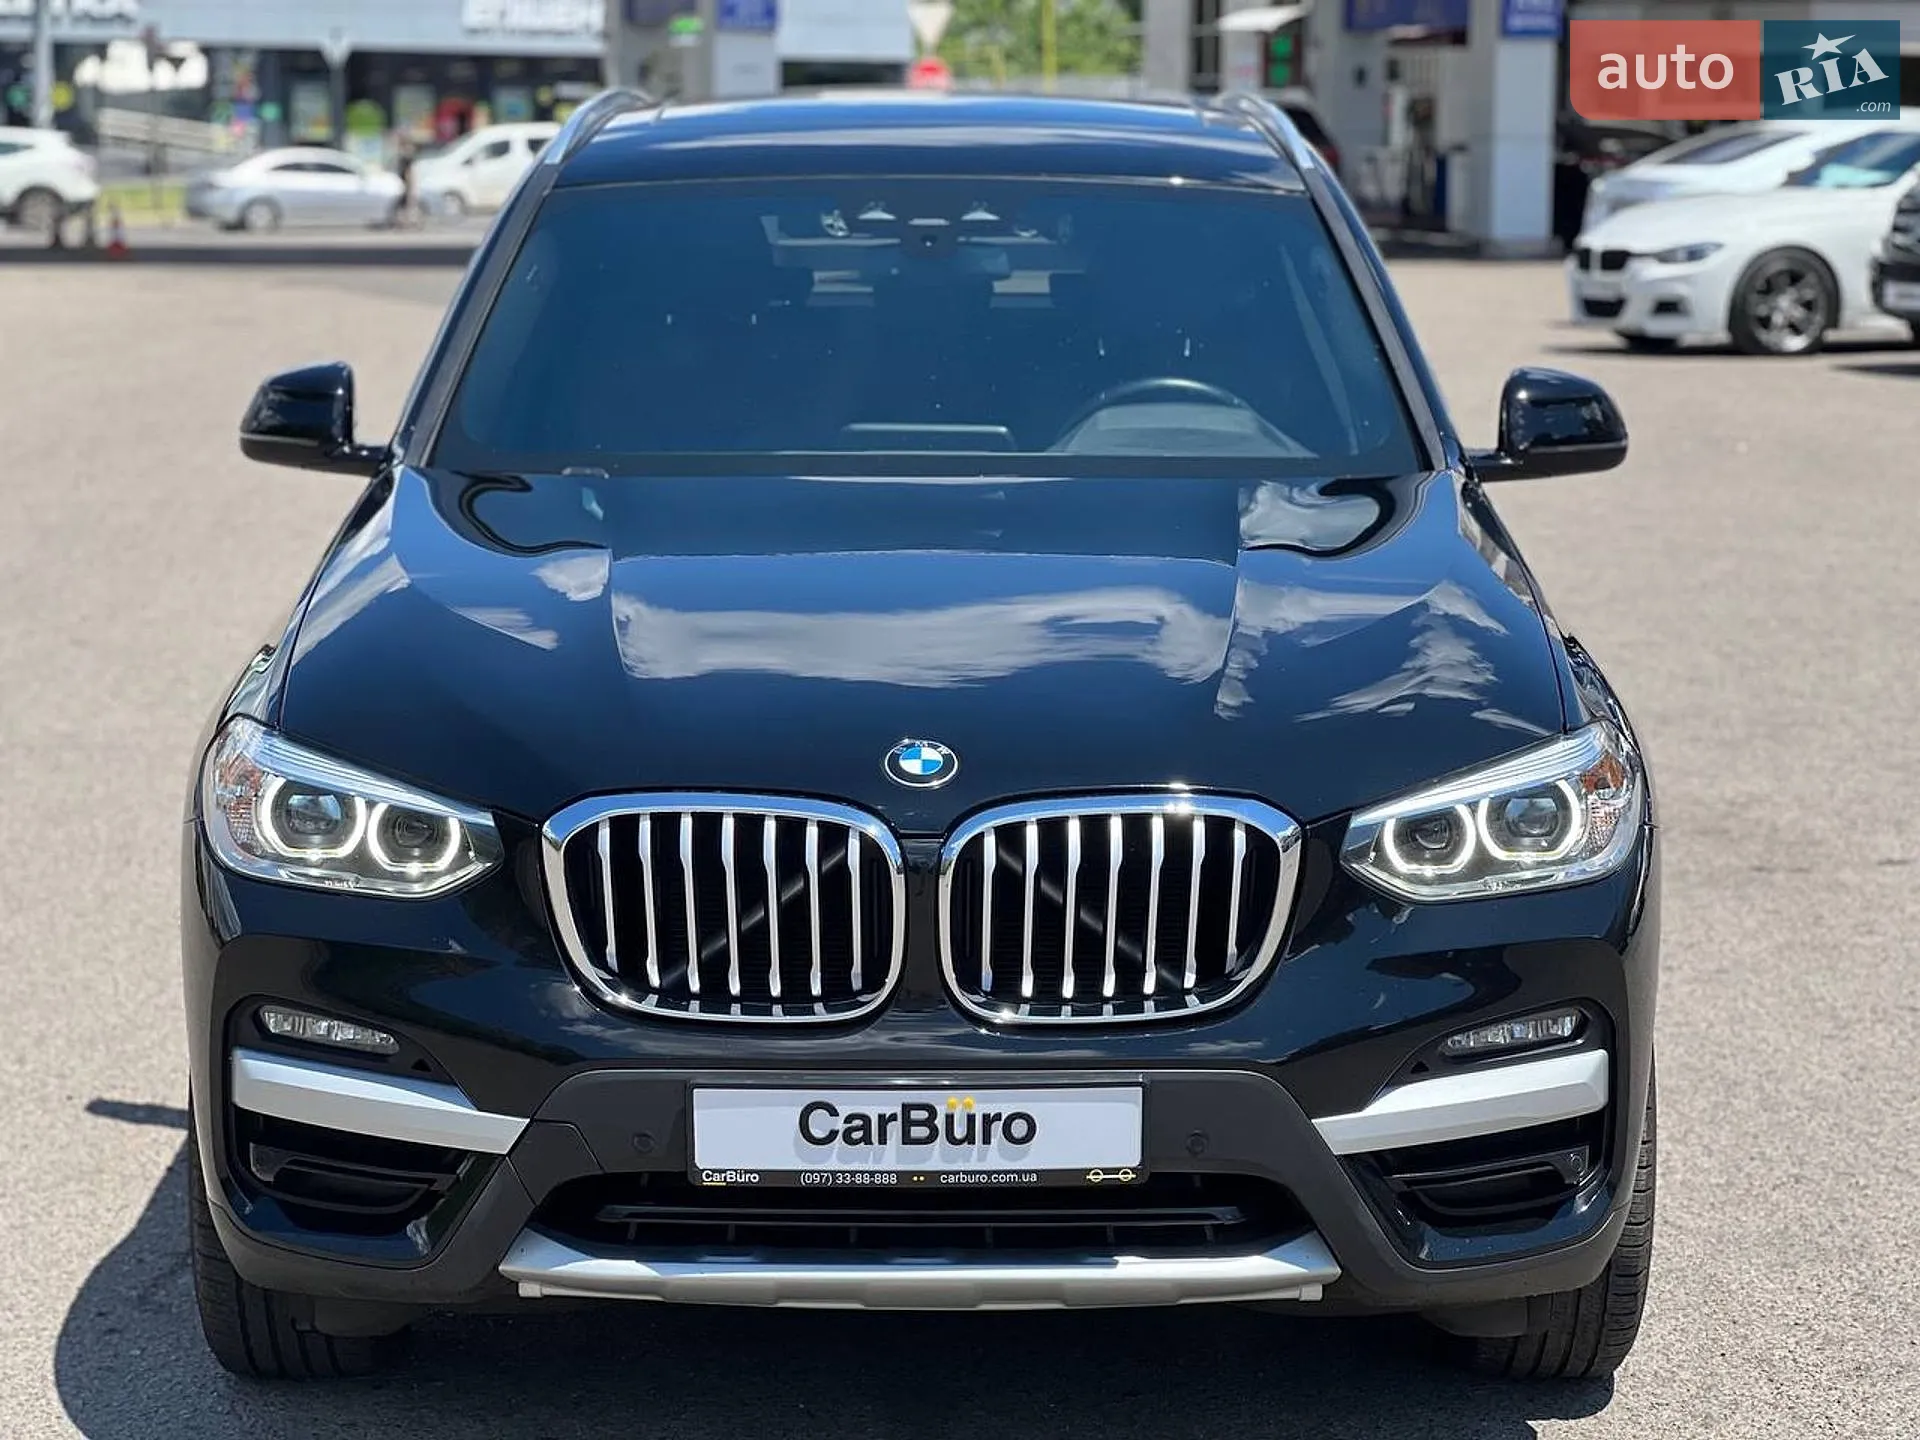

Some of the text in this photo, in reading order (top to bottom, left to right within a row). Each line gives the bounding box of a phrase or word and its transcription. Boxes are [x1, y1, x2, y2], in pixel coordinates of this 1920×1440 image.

[798, 1096, 1038, 1146] CarBüro
[702, 1170, 1037, 1185] CarBüro (097) 33-88-888 carburo.com.ua
